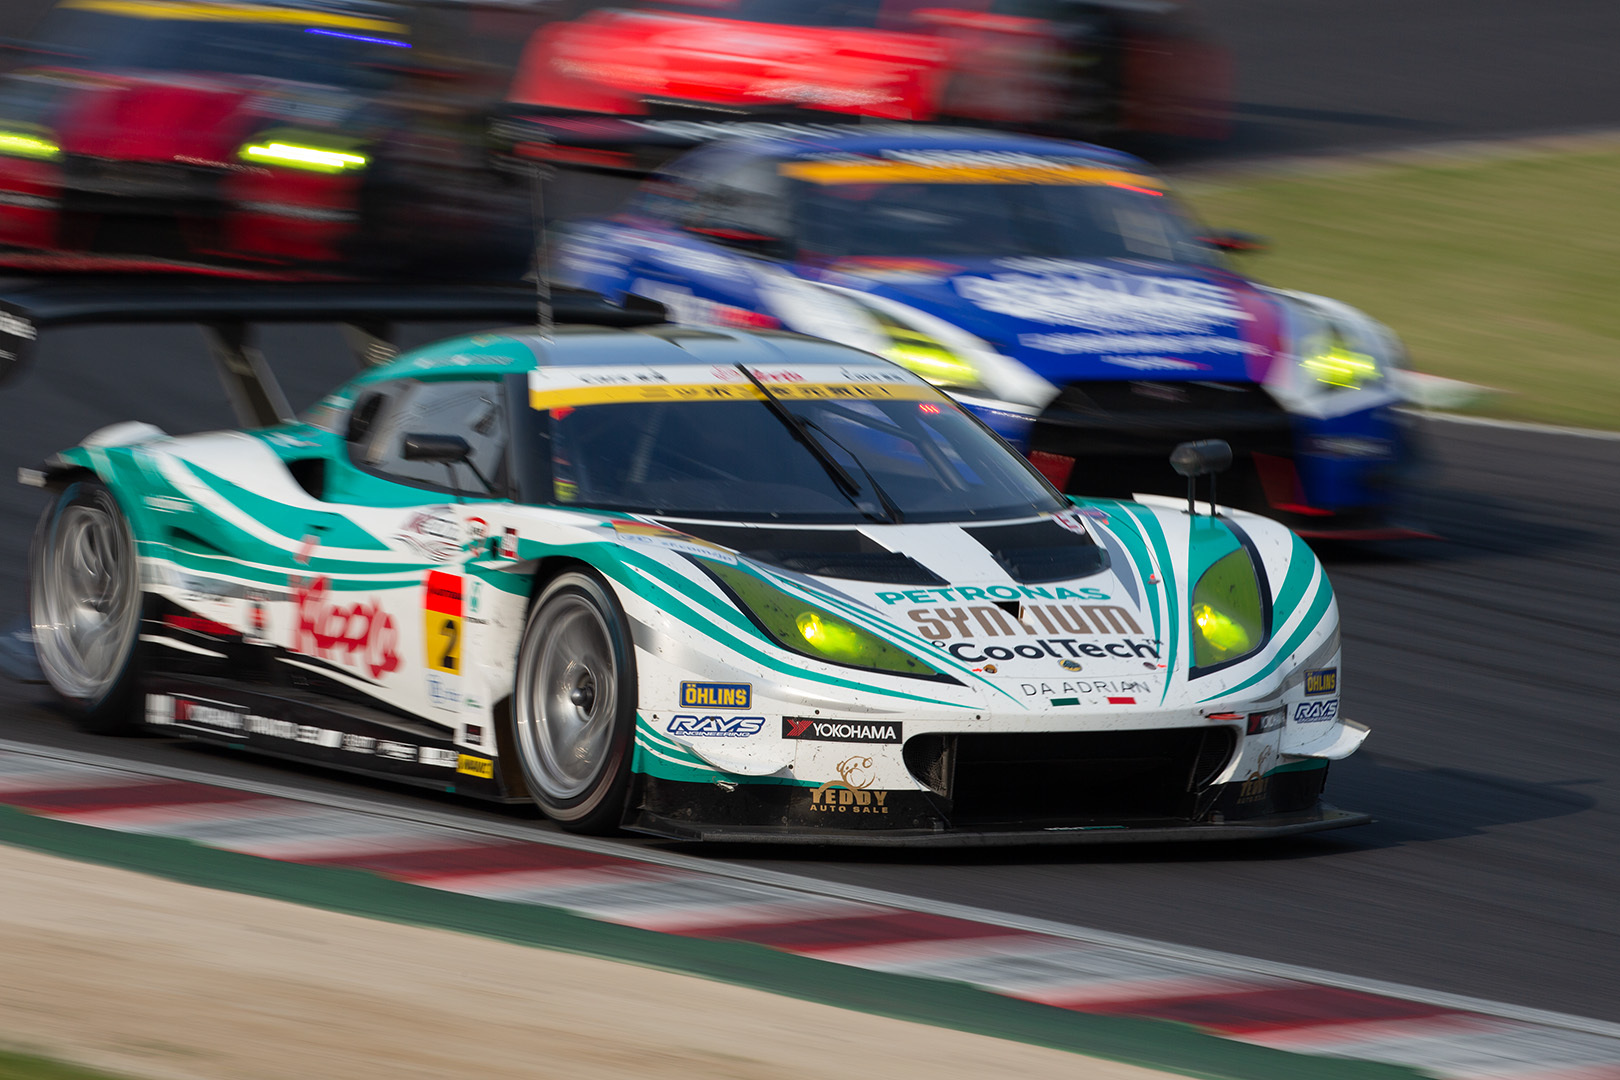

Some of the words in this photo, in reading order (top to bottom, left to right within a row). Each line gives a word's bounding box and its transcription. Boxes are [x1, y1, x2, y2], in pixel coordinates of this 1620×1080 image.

[874, 585, 1112, 605] PETRONAS
[439, 618, 461, 670] 2
[1021, 682, 1056, 696] DA
[1063, 680, 1152, 695] ADRIAN
[1307, 672, 1336, 692] ÖHLINS
[685, 683, 747, 706] ÖHLINS
[1294, 699, 1339, 722] RAYS
[667, 715, 766, 735] RAYS
[675, 730, 751, 738] ENGINEERING
[812, 721, 897, 740] YOKOHAMA
[809, 787, 888, 806] TEDDY
[809, 804, 847, 812] AUTO
[852, 805, 889, 814] SALE
